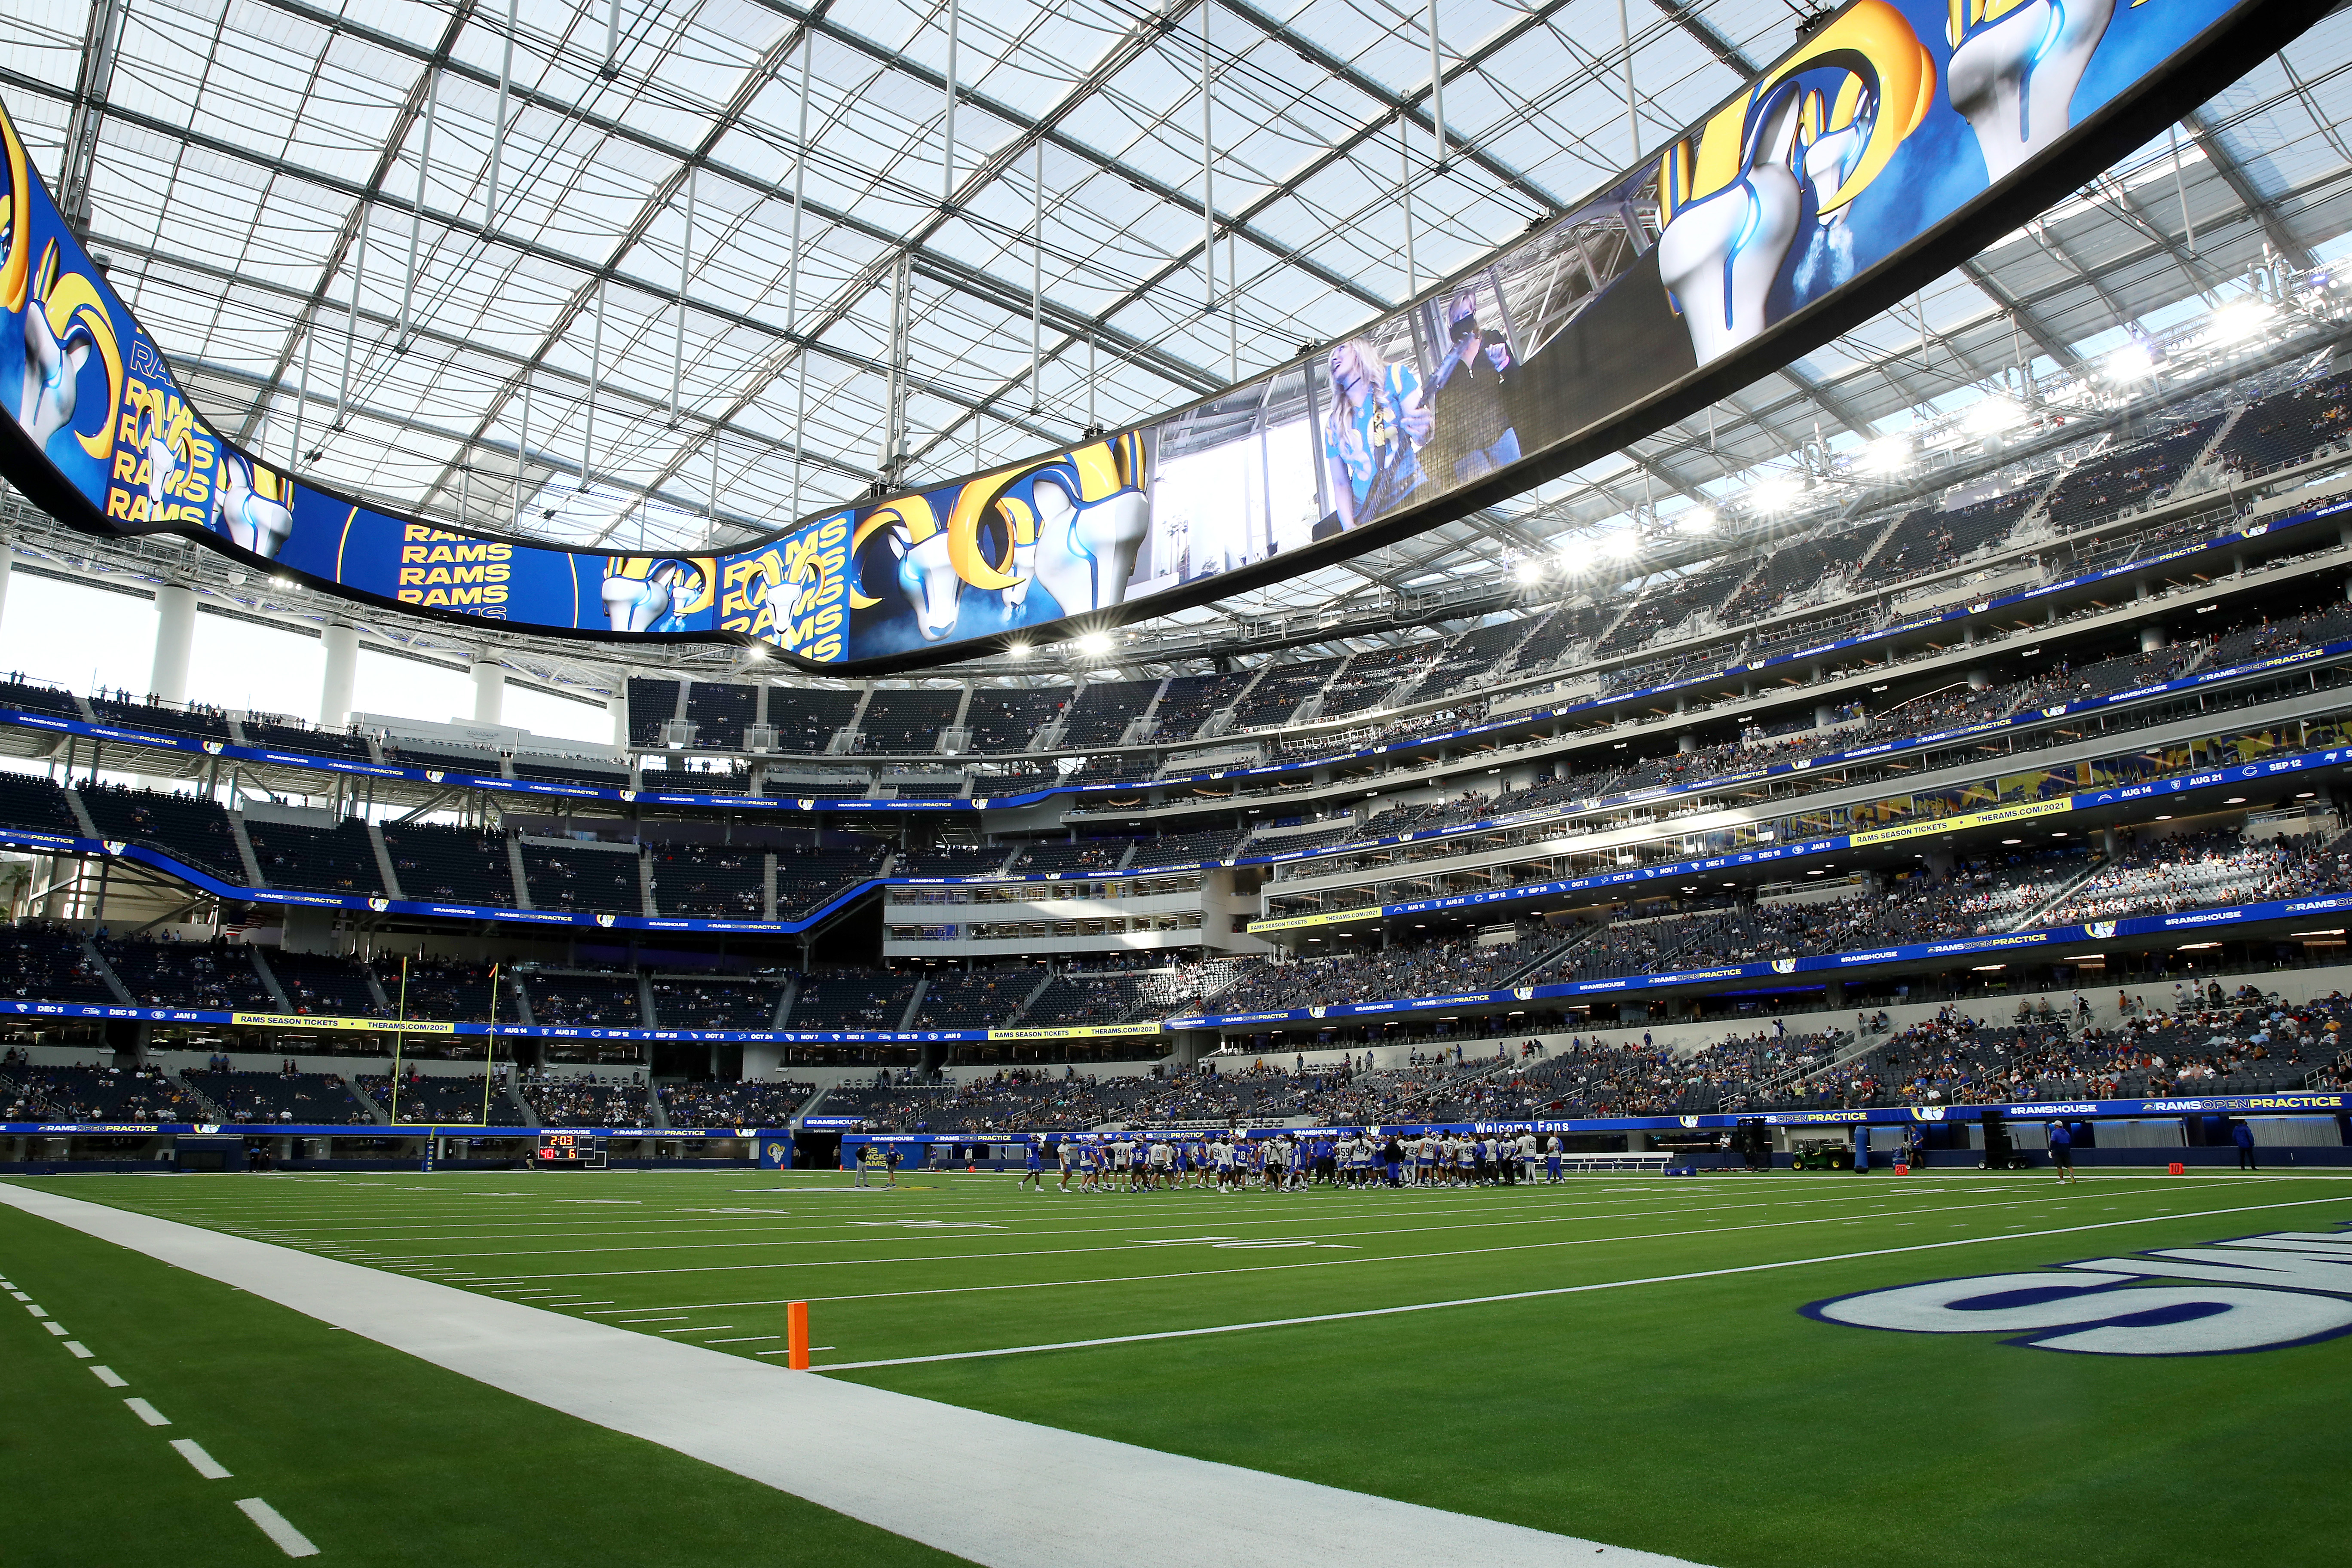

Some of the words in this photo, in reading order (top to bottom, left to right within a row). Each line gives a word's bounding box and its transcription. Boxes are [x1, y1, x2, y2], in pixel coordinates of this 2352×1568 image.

[402, 543, 512, 564] RAMS
[399, 564, 511, 585] RAMS
[397, 585, 509, 606] RAMS
[2109, 685, 2167, 701] #RAMSHOUSE
[2269, 761, 2289, 771] SEP
[2290, 759, 2302, 767] 12
[2190, 775, 2210, 786] AUG
[2211, 773, 2222, 781] 21
[2121, 788, 2141, 798] AUG
[2141, 786, 2152, 794] 14
[1976, 802, 2064, 823] THERAMS.COM/2021
[1857, 835, 1878, 843] RAMS
[1880, 829, 1912, 839] SEASON
[1914, 822, 1947, 834] TICKETS
[1811, 842, 1825, 850] JAN
[1325, 910, 1378, 922] THERAMS.COM/2021
[2165, 911, 2242, 925] #RAMSHOUSE
[1841, 951, 1897, 962] #RAMSHOUSE
[1580, 981, 1625, 990] #RAMSHOUSE
[368, 1022, 448, 1031] THERAMS.COM/2021
[1091, 1026, 1156, 1035] THERAMS.COM/2021
[2011, 1105, 2097, 1114] #RAMSHOUSE
[1474, 1121, 1532, 1133] Welcome
[1537, 1121, 1569, 1132] Fans
[551, 1136, 573, 1145] 2:03
[1341, 1147, 1350, 1157] 59
[1425, 1143, 1433, 1152] 92
[540, 1149, 554, 1158] 40
[569, 1149, 575, 1158] 6
[1135, 1152, 1142, 1161] 16
[1237, 1151, 1246, 1160] 18
